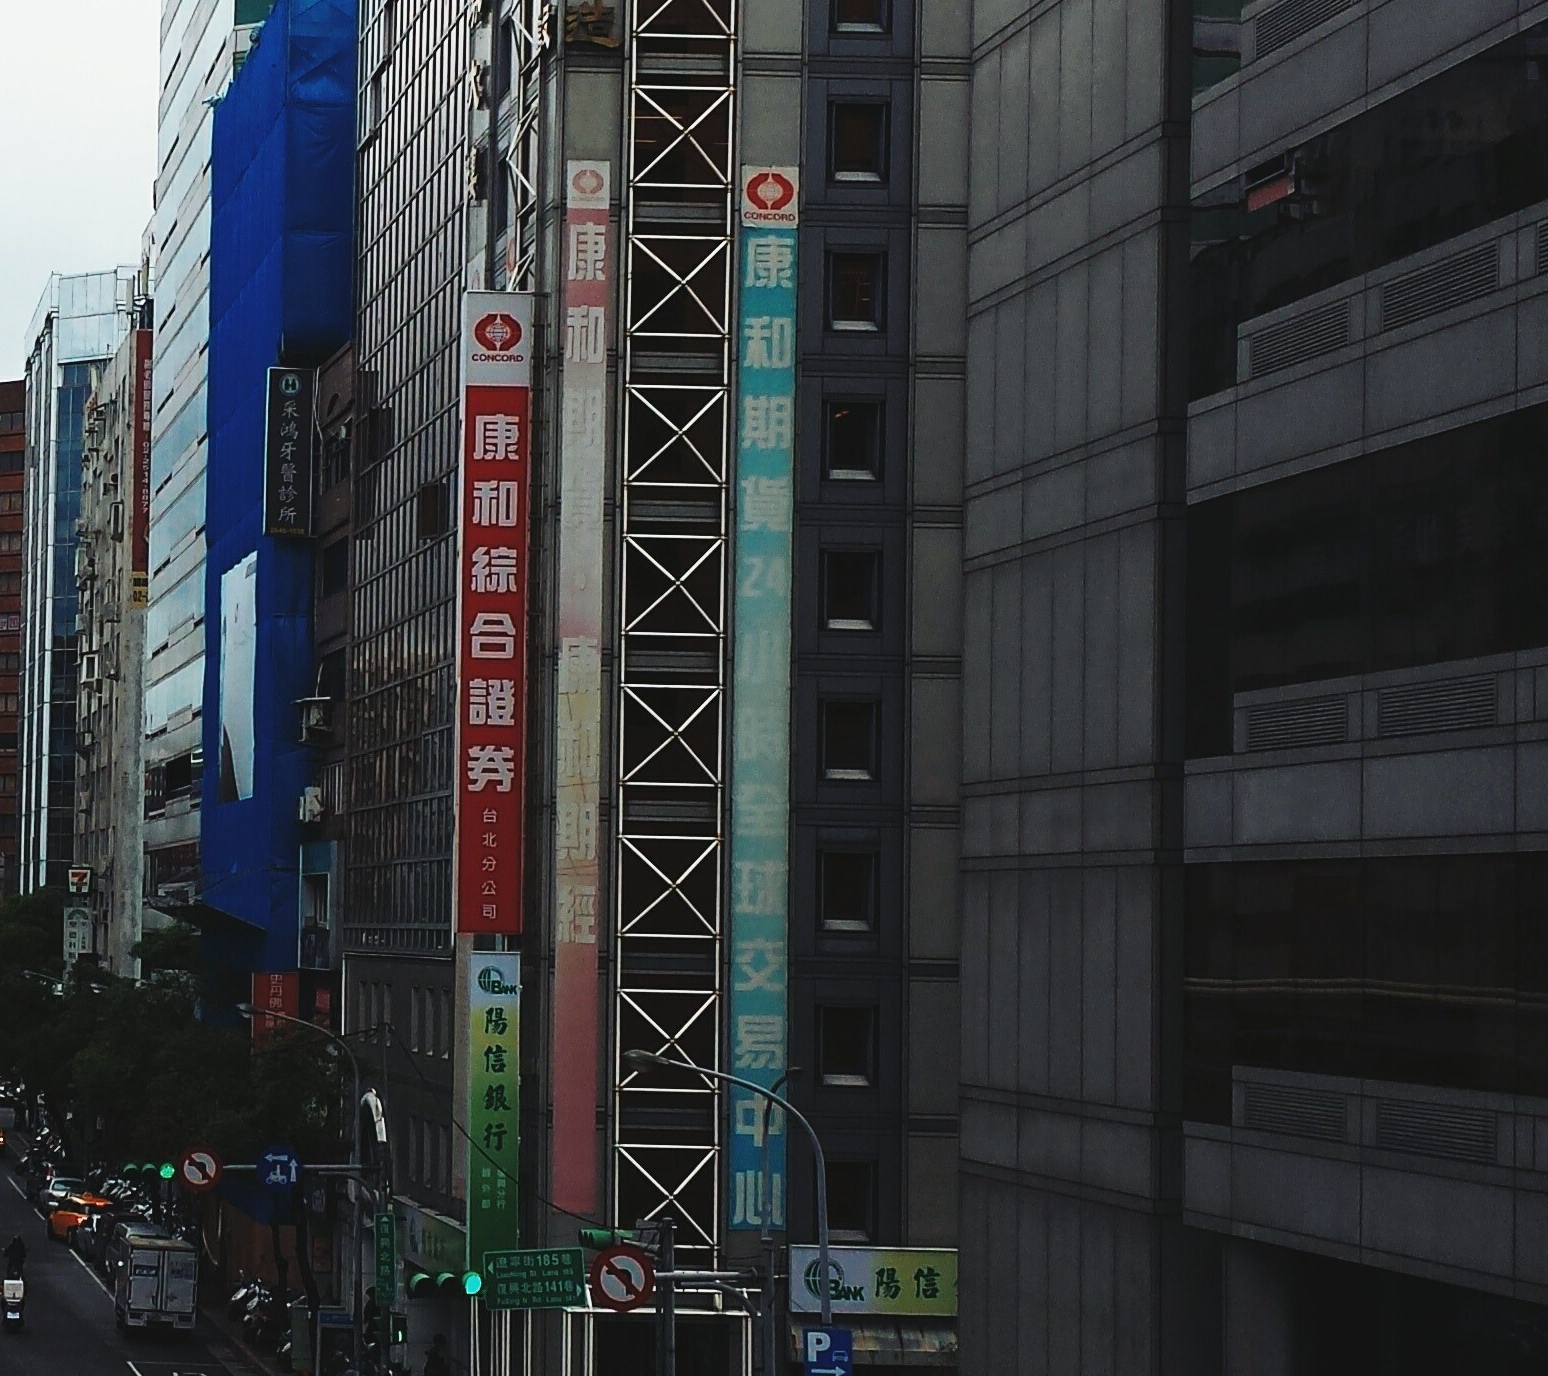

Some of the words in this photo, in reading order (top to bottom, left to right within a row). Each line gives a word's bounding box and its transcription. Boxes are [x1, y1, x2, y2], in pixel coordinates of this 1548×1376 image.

[744, 211, 796, 222] CONCORD
[471, 353, 524, 364] CONCORD
[278, 399, 301, 525] 采鴻牙醫診所
[466, 412, 520, 793] 康和綜合證券
[481, 807, 498, 920] 台北分公司
[484, 1007, 512, 1151] 陽信銀行
[874, 1266, 942, 1300] 陽信
[807, 1332, 831, 1362] P
